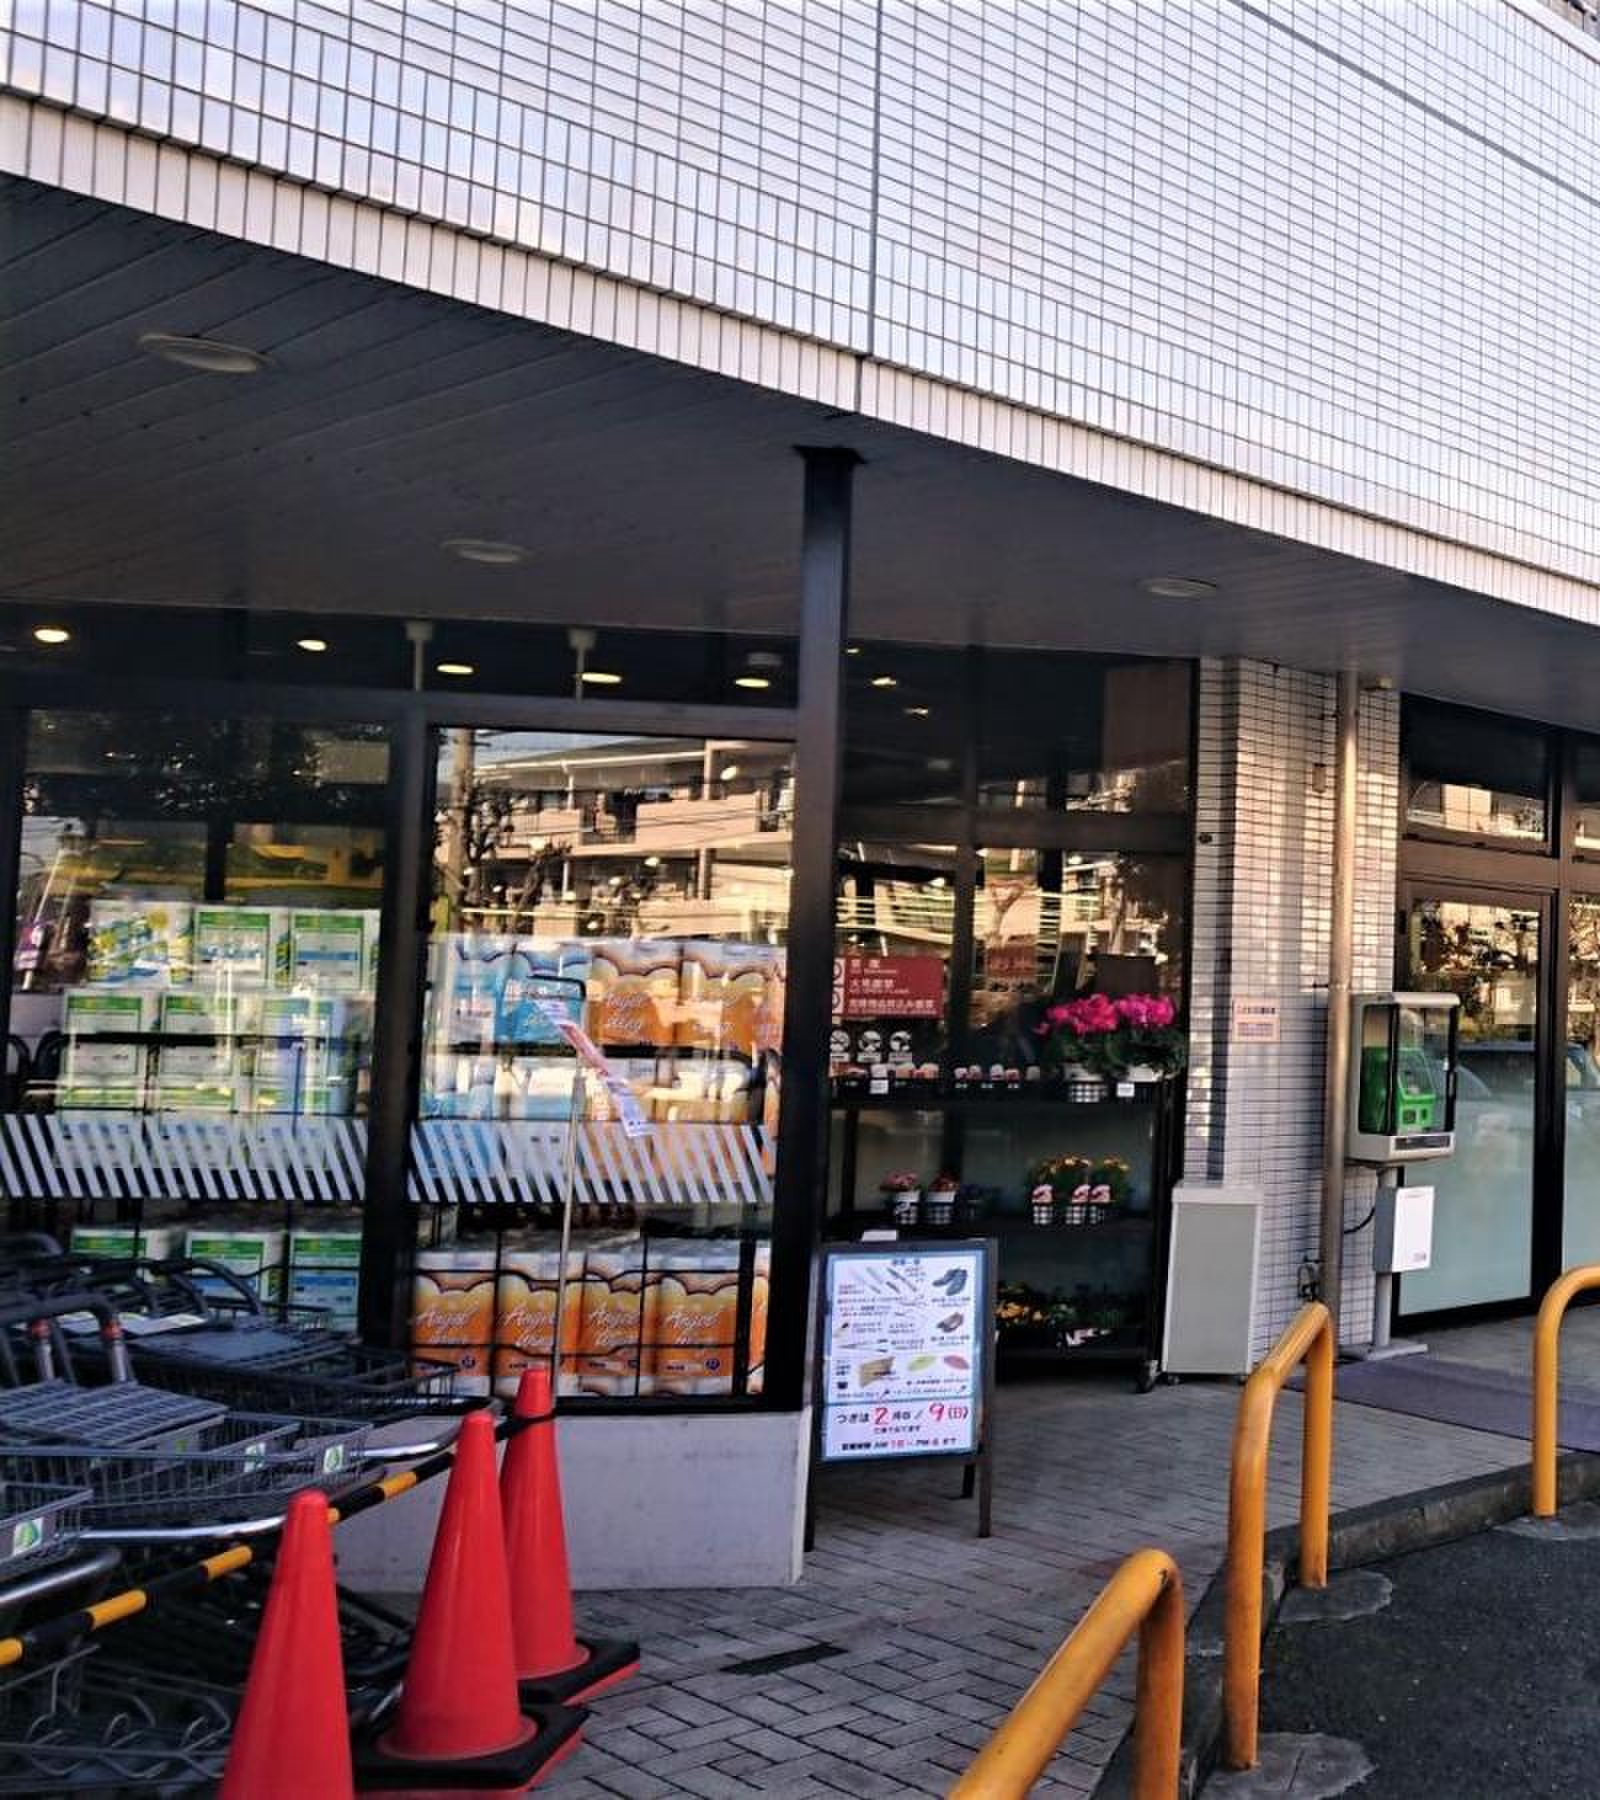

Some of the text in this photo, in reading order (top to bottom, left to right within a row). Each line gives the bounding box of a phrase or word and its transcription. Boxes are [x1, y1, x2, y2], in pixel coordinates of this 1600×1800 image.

[837, 1412, 869, 1424] つぎは
[874, 1407, 888, 1424] 2
[929, 1402, 945, 1422] 9
